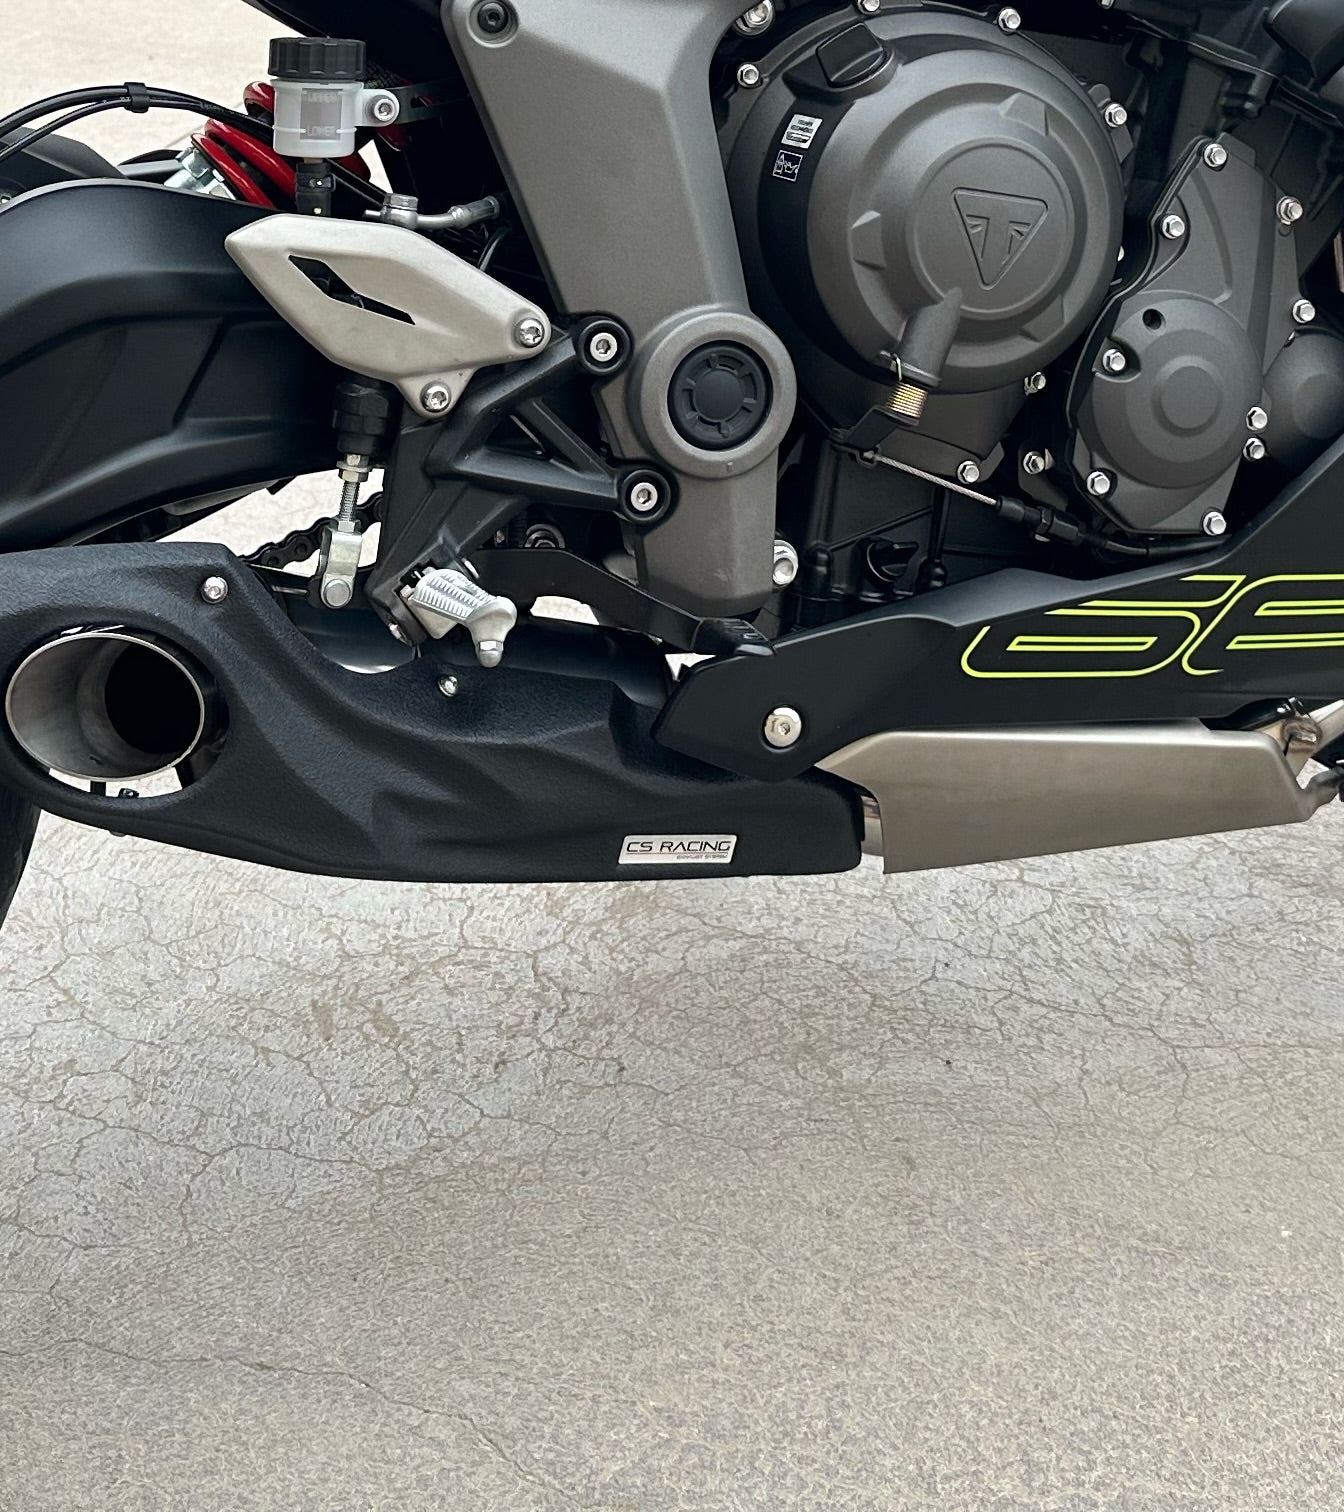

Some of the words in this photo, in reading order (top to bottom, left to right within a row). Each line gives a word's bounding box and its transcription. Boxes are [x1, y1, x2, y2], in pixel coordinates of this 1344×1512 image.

[307, 125, 336, 136] LOWER
[626, 841, 654, 853] CS
[659, 840, 732, 853] RACING
